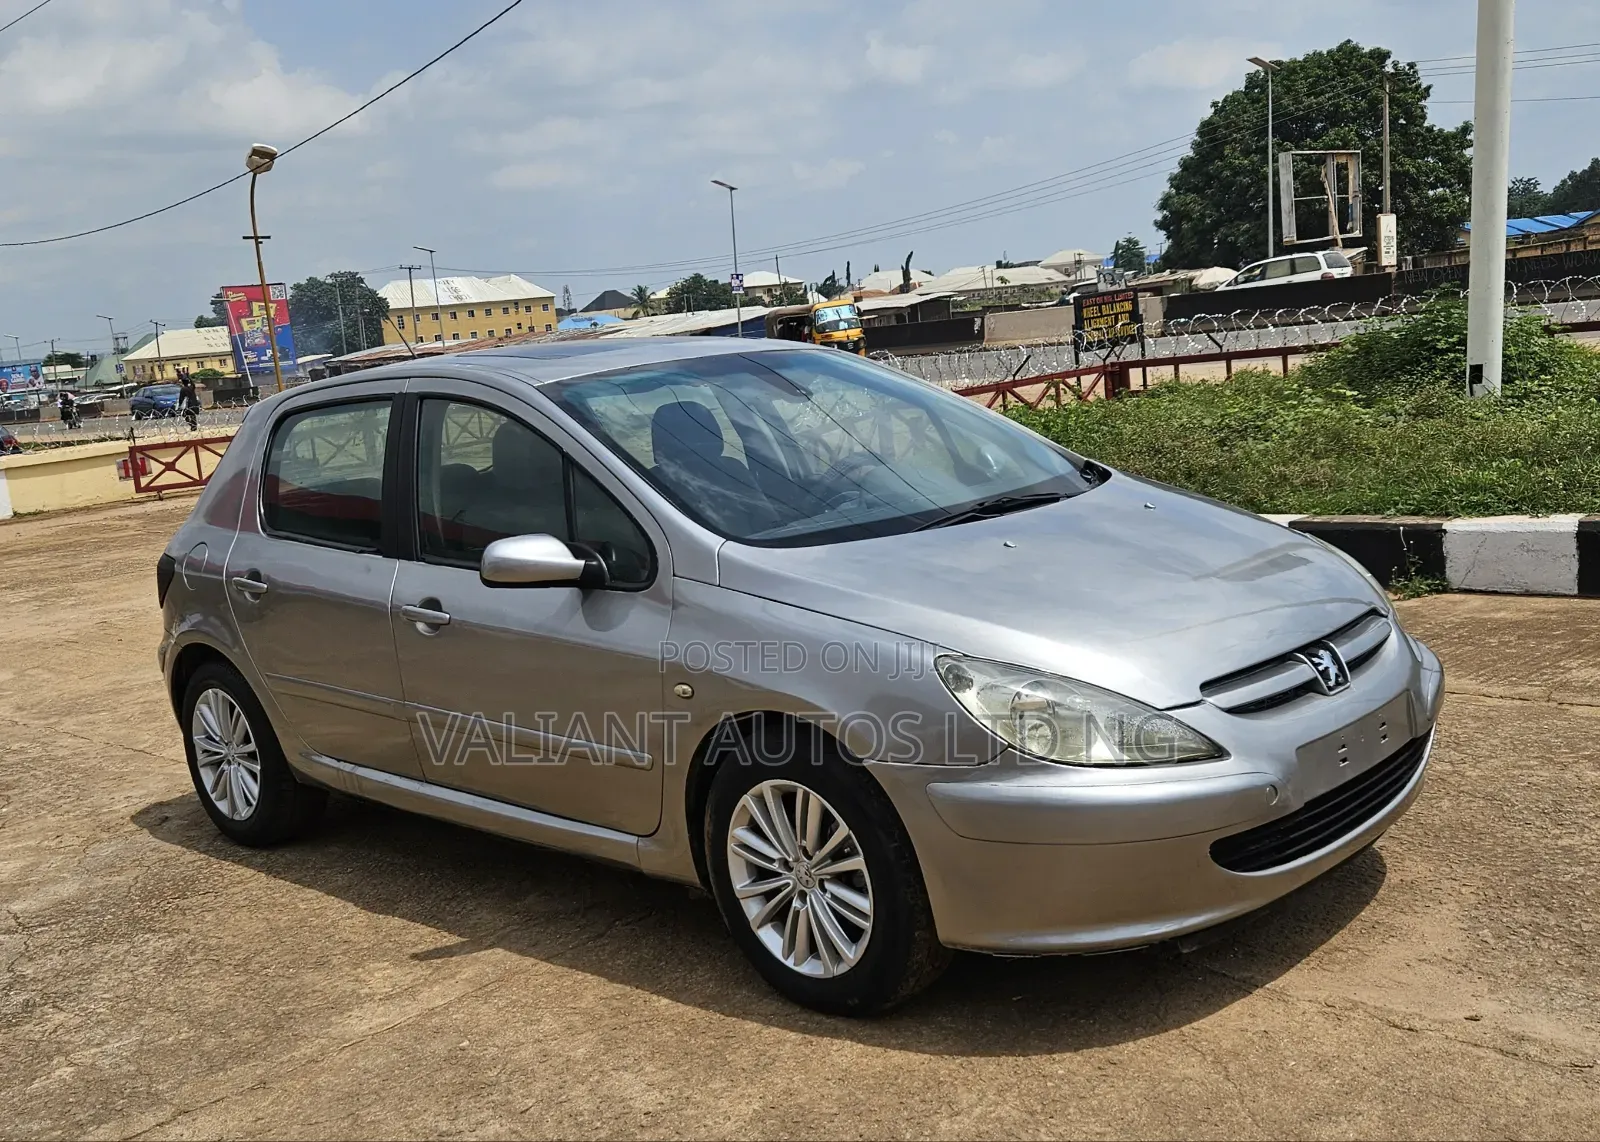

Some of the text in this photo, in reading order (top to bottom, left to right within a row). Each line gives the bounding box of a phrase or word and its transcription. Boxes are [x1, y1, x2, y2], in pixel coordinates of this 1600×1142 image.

[1083, 301, 1132, 318] WHEEL BALANCING
[1084, 314, 1115, 330] ALIGNMENT
